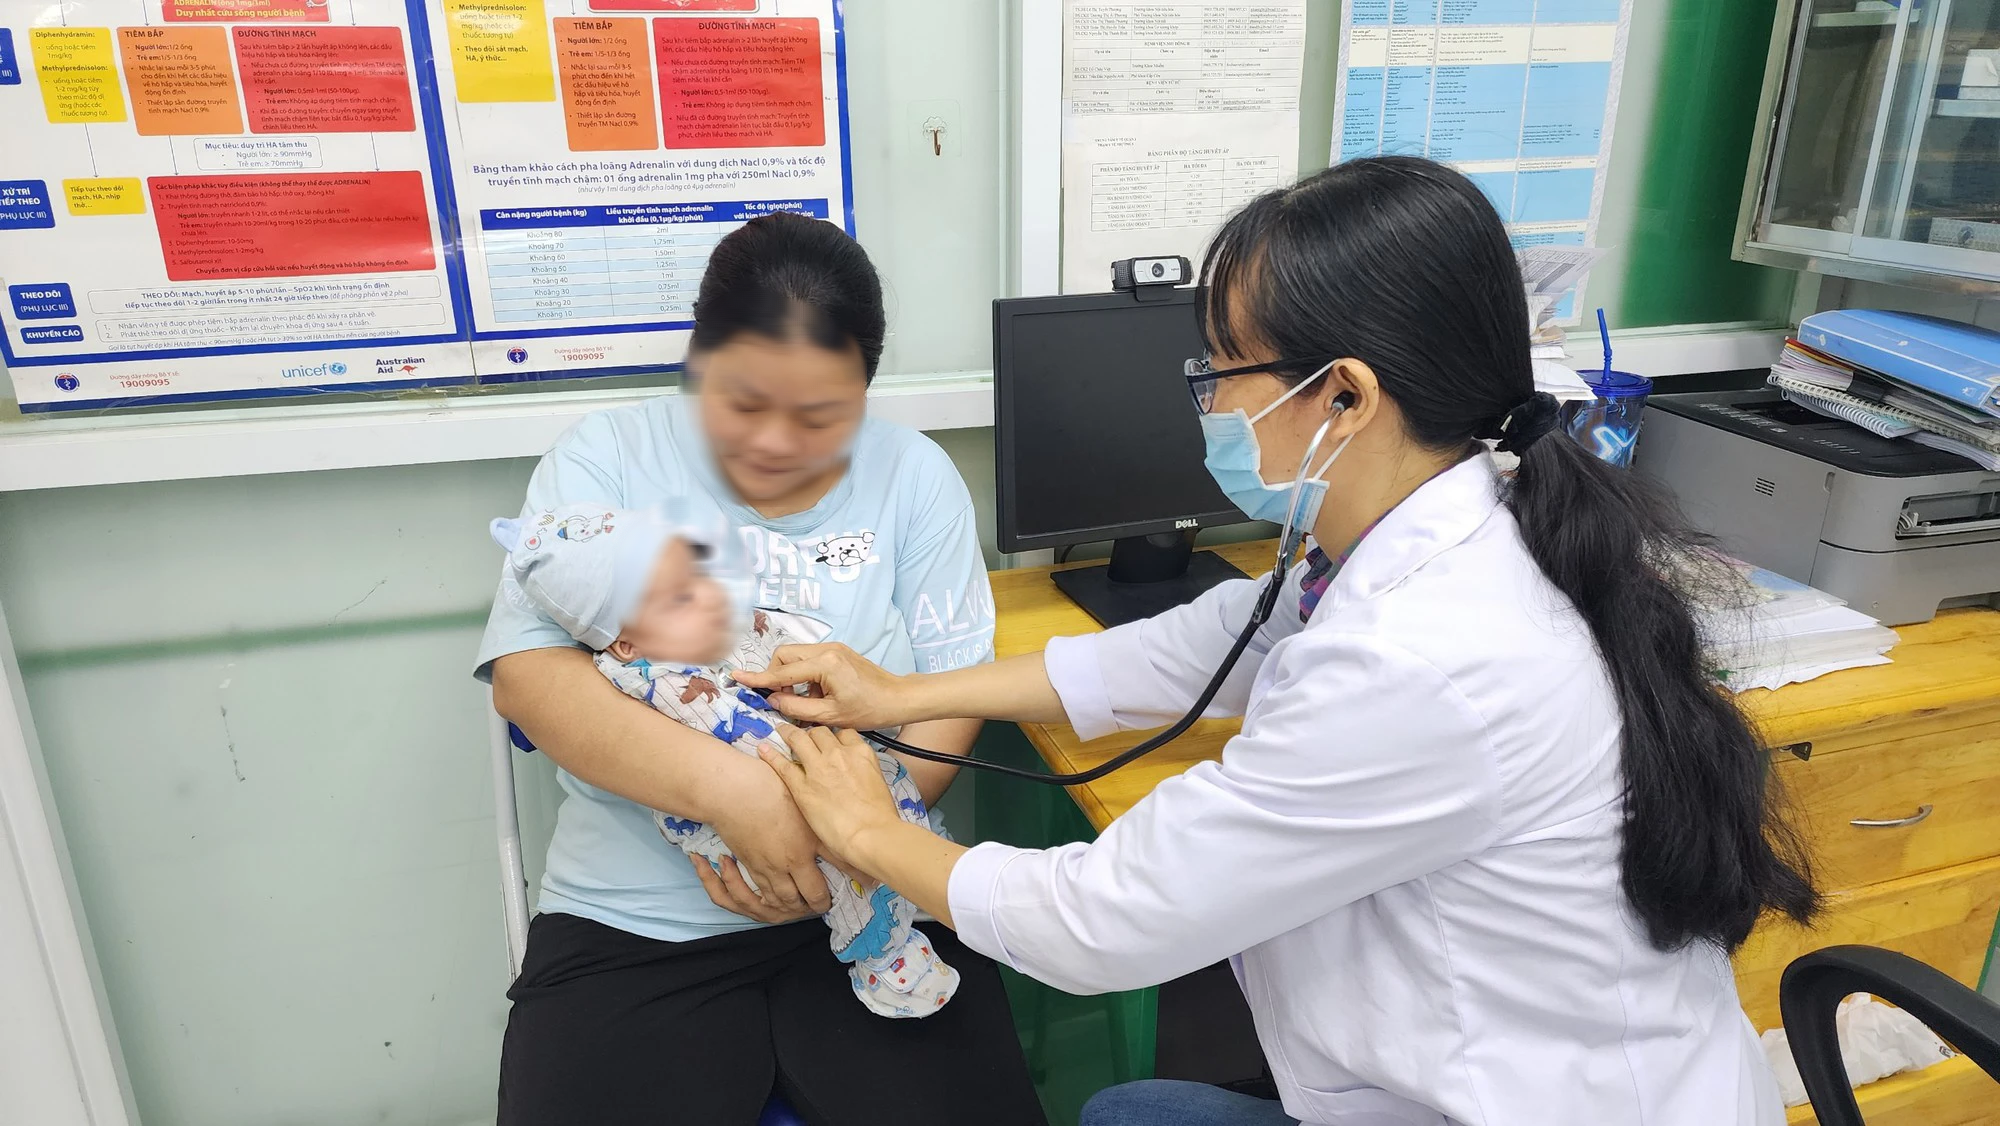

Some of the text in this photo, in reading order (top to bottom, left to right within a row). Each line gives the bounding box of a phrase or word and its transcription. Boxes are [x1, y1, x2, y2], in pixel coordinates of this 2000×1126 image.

[235, 9, 255, 17] sống
[574, 20, 612, 30] TIÊM BẮP
[699, 22, 729, 30] ĐƯỜNG
[752, 23, 776, 31] MẠCH
[292, 30, 316, 39] MẠCH
[473, 156, 826, 174] Bảng tham khảo cách pha loãng Adrenalin với dung dịch Nacl 0,9% và tốc độ
[523, 176, 543, 185] tĩnh
[545, 176, 571, 186] mạch
[618, 173, 636, 184] ống
[638, 173, 682, 182] adrenalin
[686, 173, 704, 182] 1mg
[707, 172, 724, 181] pha
[726, 171, 740, 179] với
[742, 170, 770, 179] 250ml
[772, 170, 791, 178] Nacl
[793, 169, 815, 178] 0,9%
[573, 209, 587, 217] (kg)
[42, 304, 58, 312] LỤC
[26, 329, 80, 339] KHUYẾN CÁO
[376, 357, 425, 366] Australian
[562, 353, 604, 361] 19009095
[282, 363, 327, 378] unicef
[378, 366, 393, 374] Aid
[120, 379, 170, 388] 19009095
[1176, 519, 1198, 529] DELL
